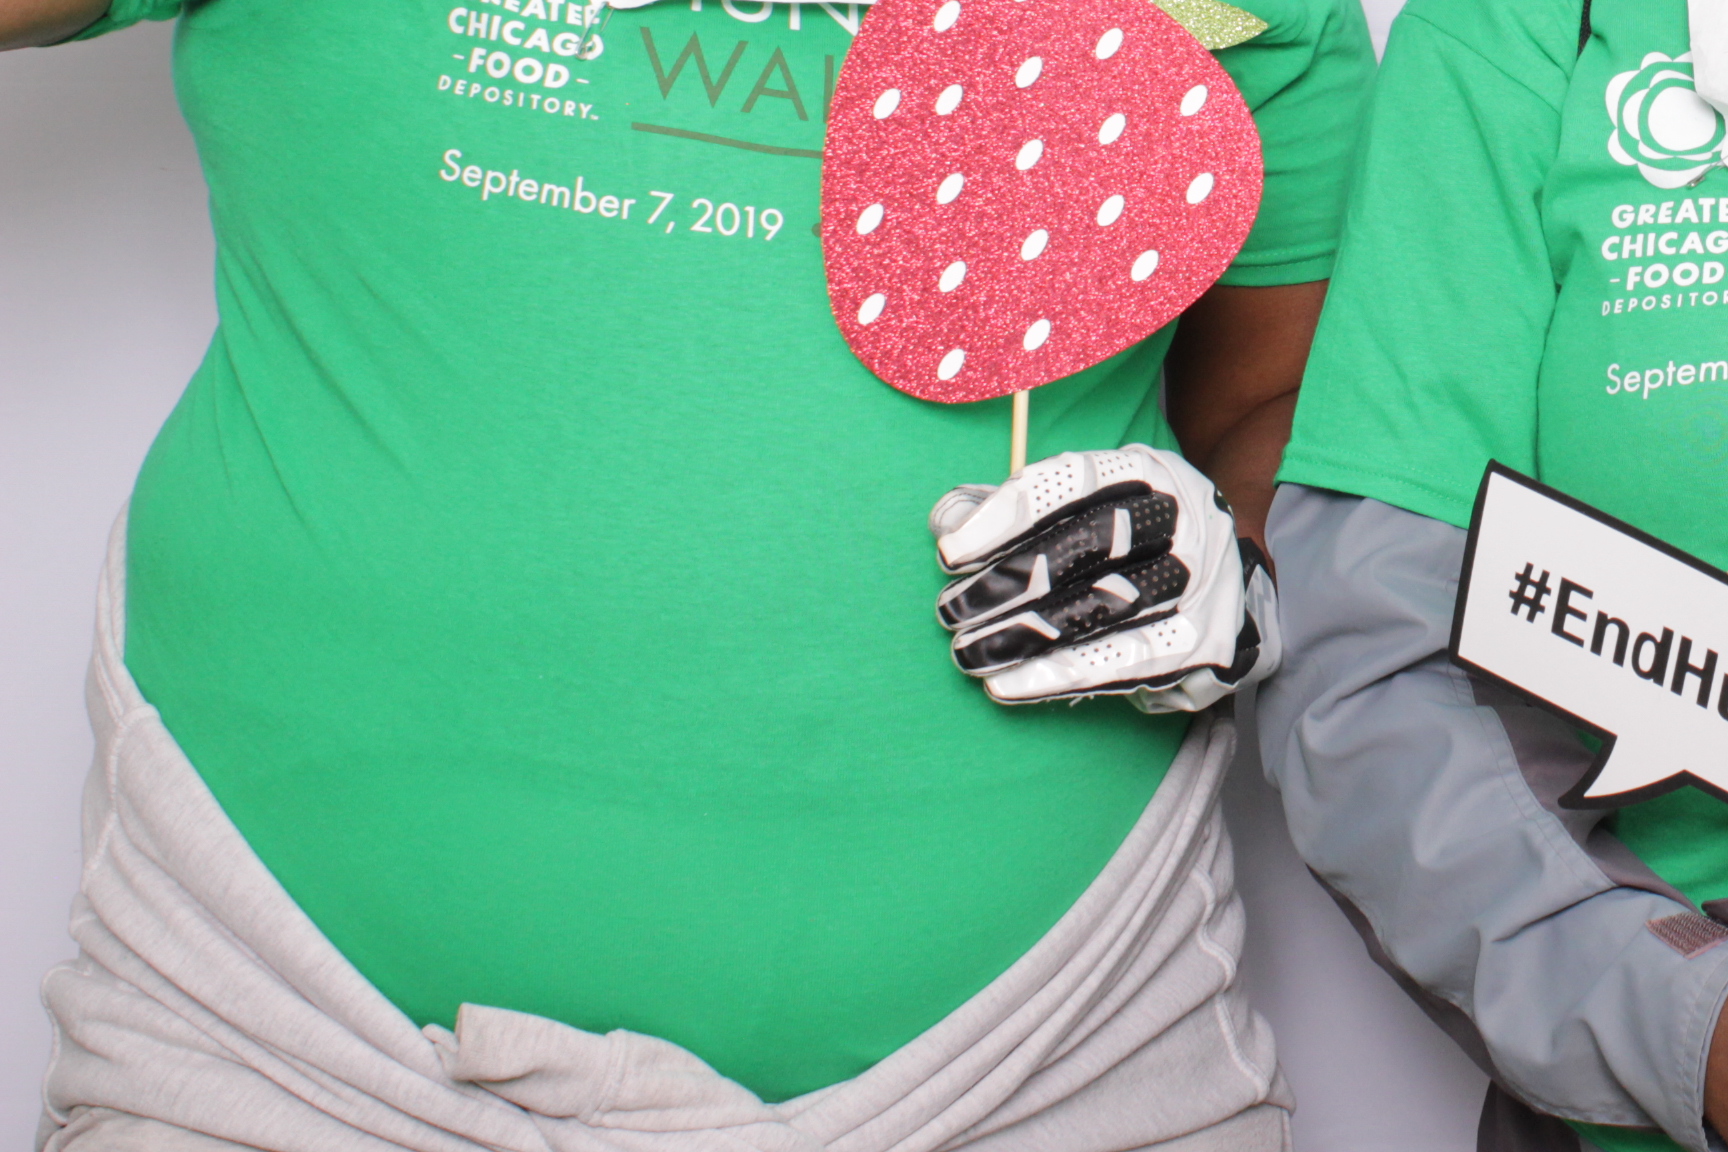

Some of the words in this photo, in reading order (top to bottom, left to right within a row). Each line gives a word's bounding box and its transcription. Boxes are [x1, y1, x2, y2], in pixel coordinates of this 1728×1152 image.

[448, 7, 604, 61] CHICAGO
[438, 148, 636, 220] September
[648, 190, 676, 235] 7,
[690, 198, 784, 241] 2019
